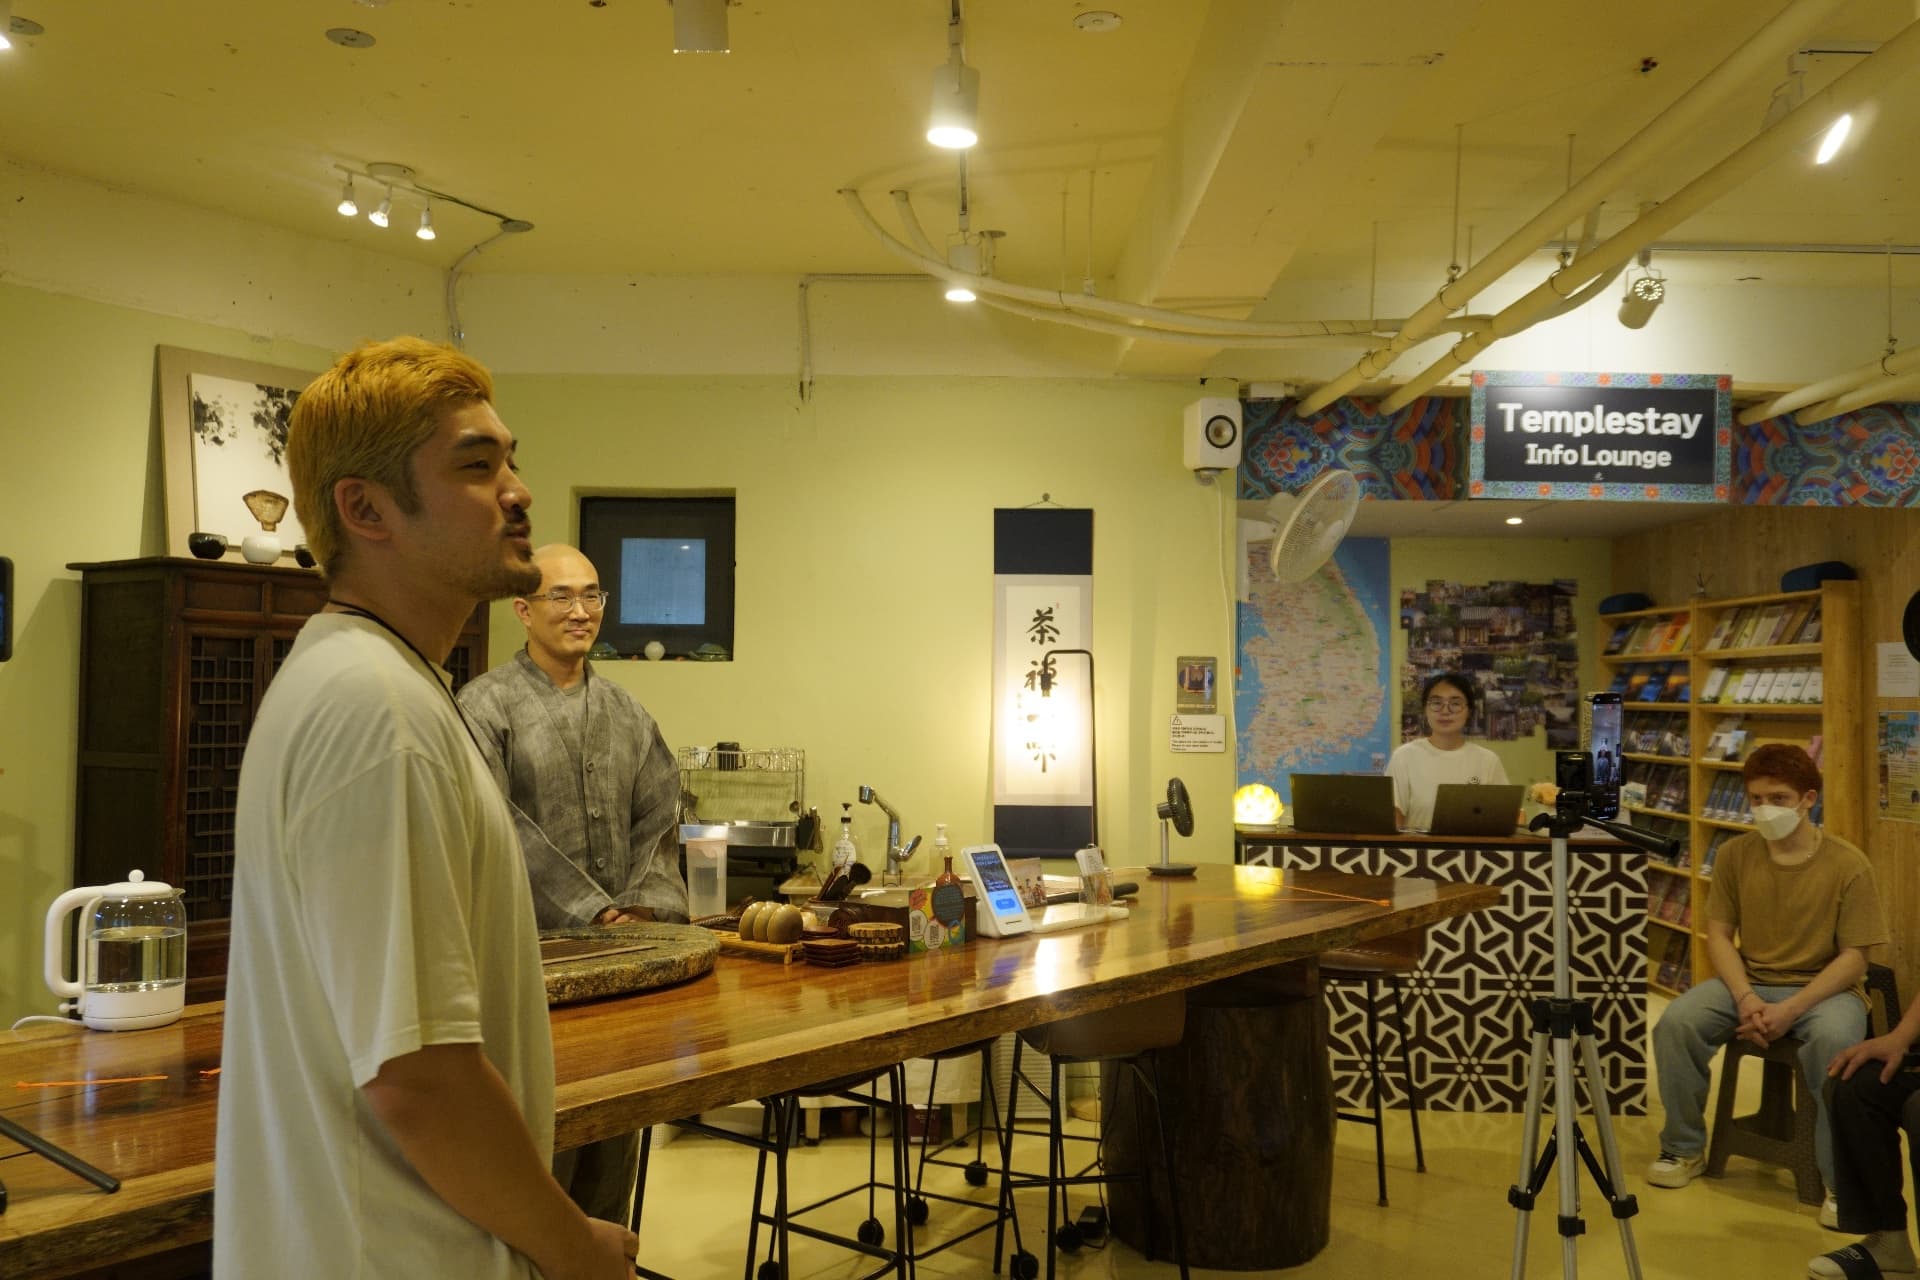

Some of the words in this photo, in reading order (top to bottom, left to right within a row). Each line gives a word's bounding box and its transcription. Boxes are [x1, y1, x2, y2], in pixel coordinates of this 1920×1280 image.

[1498, 403, 1702, 438] Templestay
[1526, 444, 1578, 465] Info
[1581, 445, 1672, 468] Lounge
